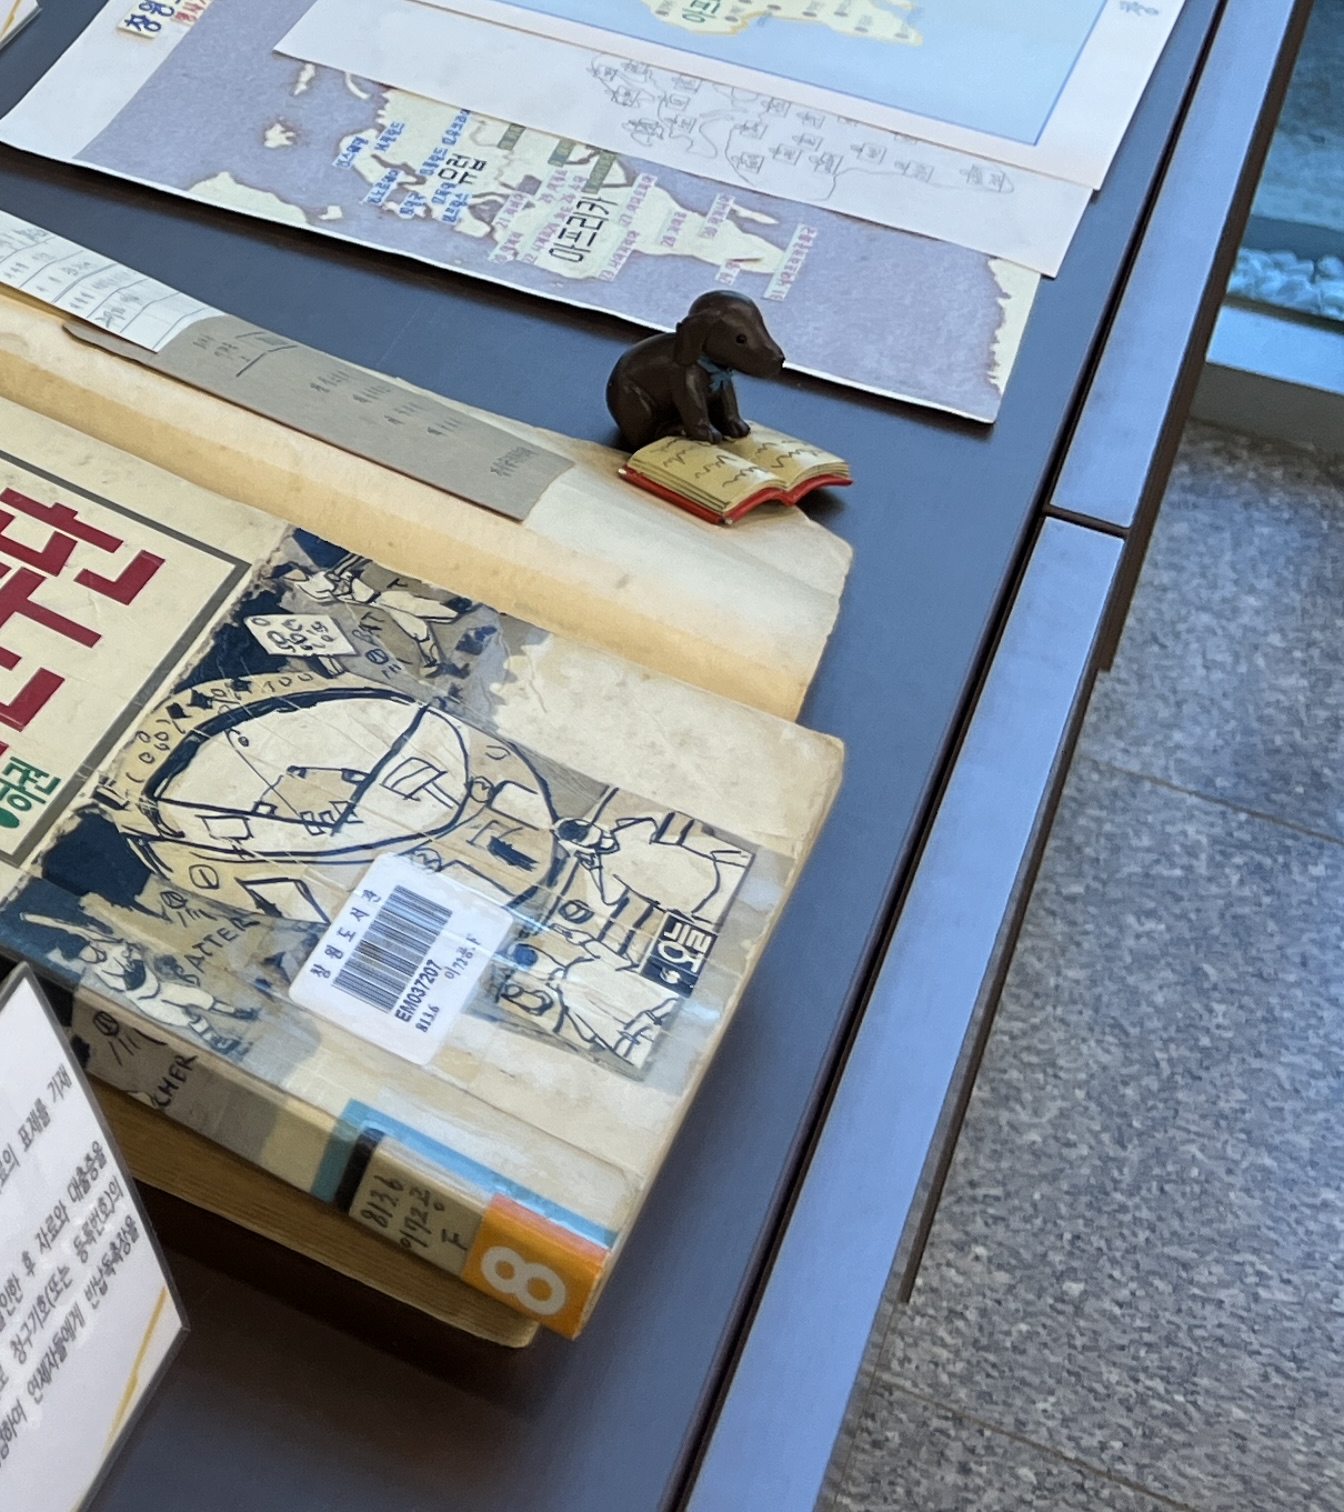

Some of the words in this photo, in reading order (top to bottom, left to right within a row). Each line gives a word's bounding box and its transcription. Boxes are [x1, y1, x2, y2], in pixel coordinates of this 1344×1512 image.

[438, 152, 488, 185] 유럽
[548, 197, 618, 264] 아프리카
[309, 887, 382, 980] 창원도서관
[395, 957, 443, 1024] EM037207
[16, 1096, 52, 1152] 표제를
[46, 1063, 74, 1103] 기재
[20, 1249, 37, 1277] 후
[34, 1198, 71, 1255] 자료와
[66, 1139, 108, 1204] 대출증을
[9, 1264, 75, 1365] 청구기호(또는
[72, 1174, 125, 1264] 등록번호)의
[480, 1245, 567, 1317] 8
[26, 1300, 87, 1406] 연체자들에게
